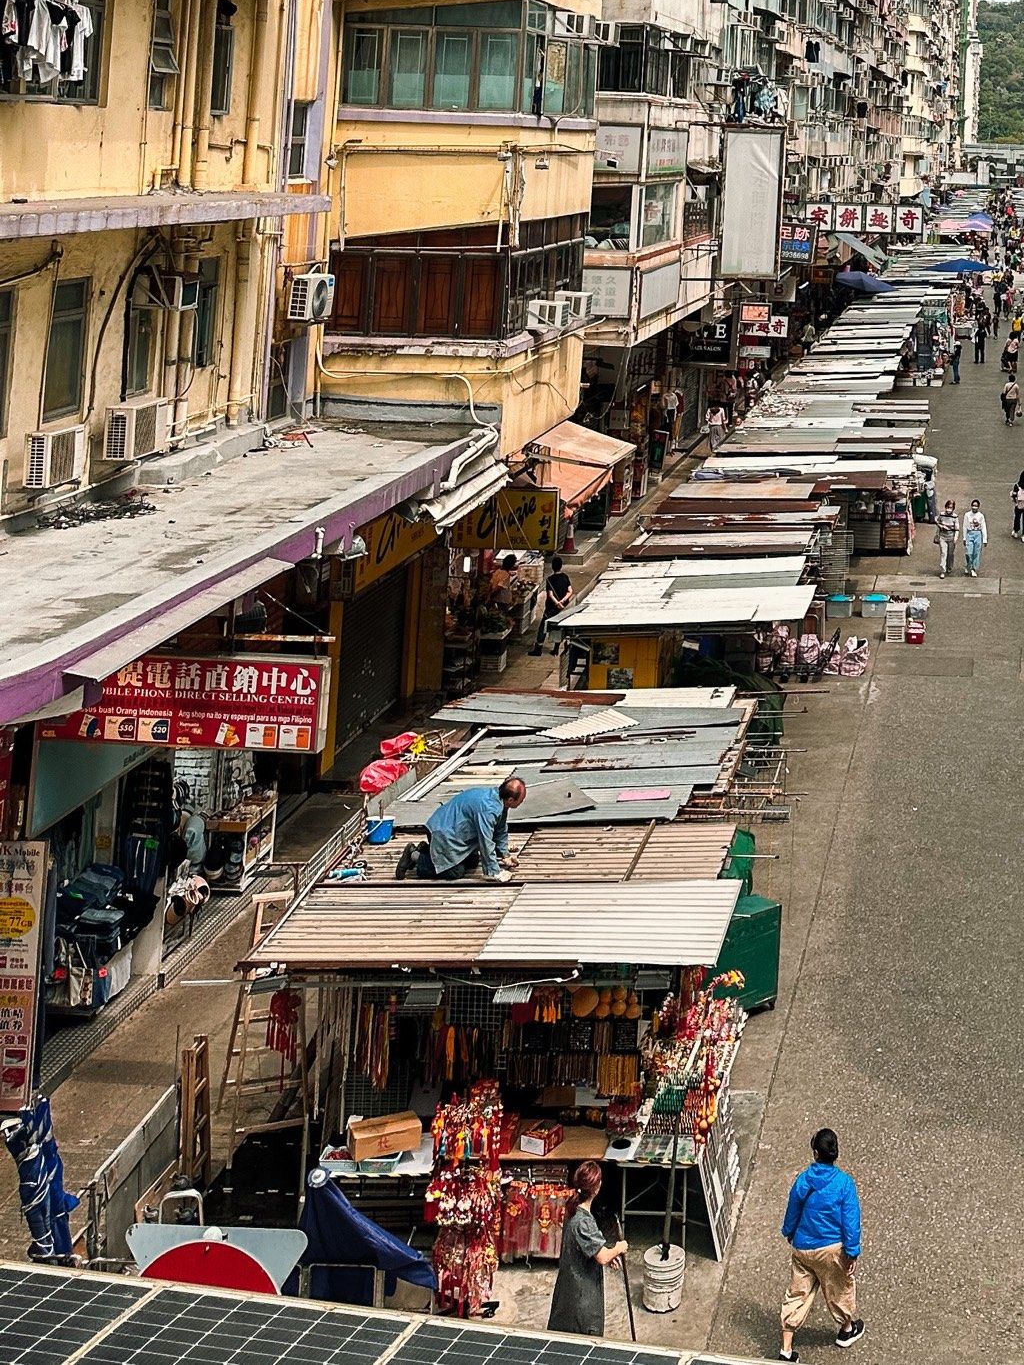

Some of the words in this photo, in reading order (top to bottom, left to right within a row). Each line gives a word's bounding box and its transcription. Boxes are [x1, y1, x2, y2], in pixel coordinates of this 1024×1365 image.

[104, 660, 317, 695] 提電話直銷中心
[134, 688, 172, 698] PHONE
[174, 690, 218, 701] DIRECT
[218, 692, 268, 704] SELLING
[269, 695, 316, 706] CENTRE
[98, 706, 115, 714] buat
[116, 707, 137, 717] Orang
[139, 708, 173, 717] Indonesia
[178, 710, 191, 719] Ang
[191, 711, 206, 719] shop
[231, 713, 256, 723] espesyal
[256, 715, 268, 723] para
[291, 715, 313, 724] Filipino
